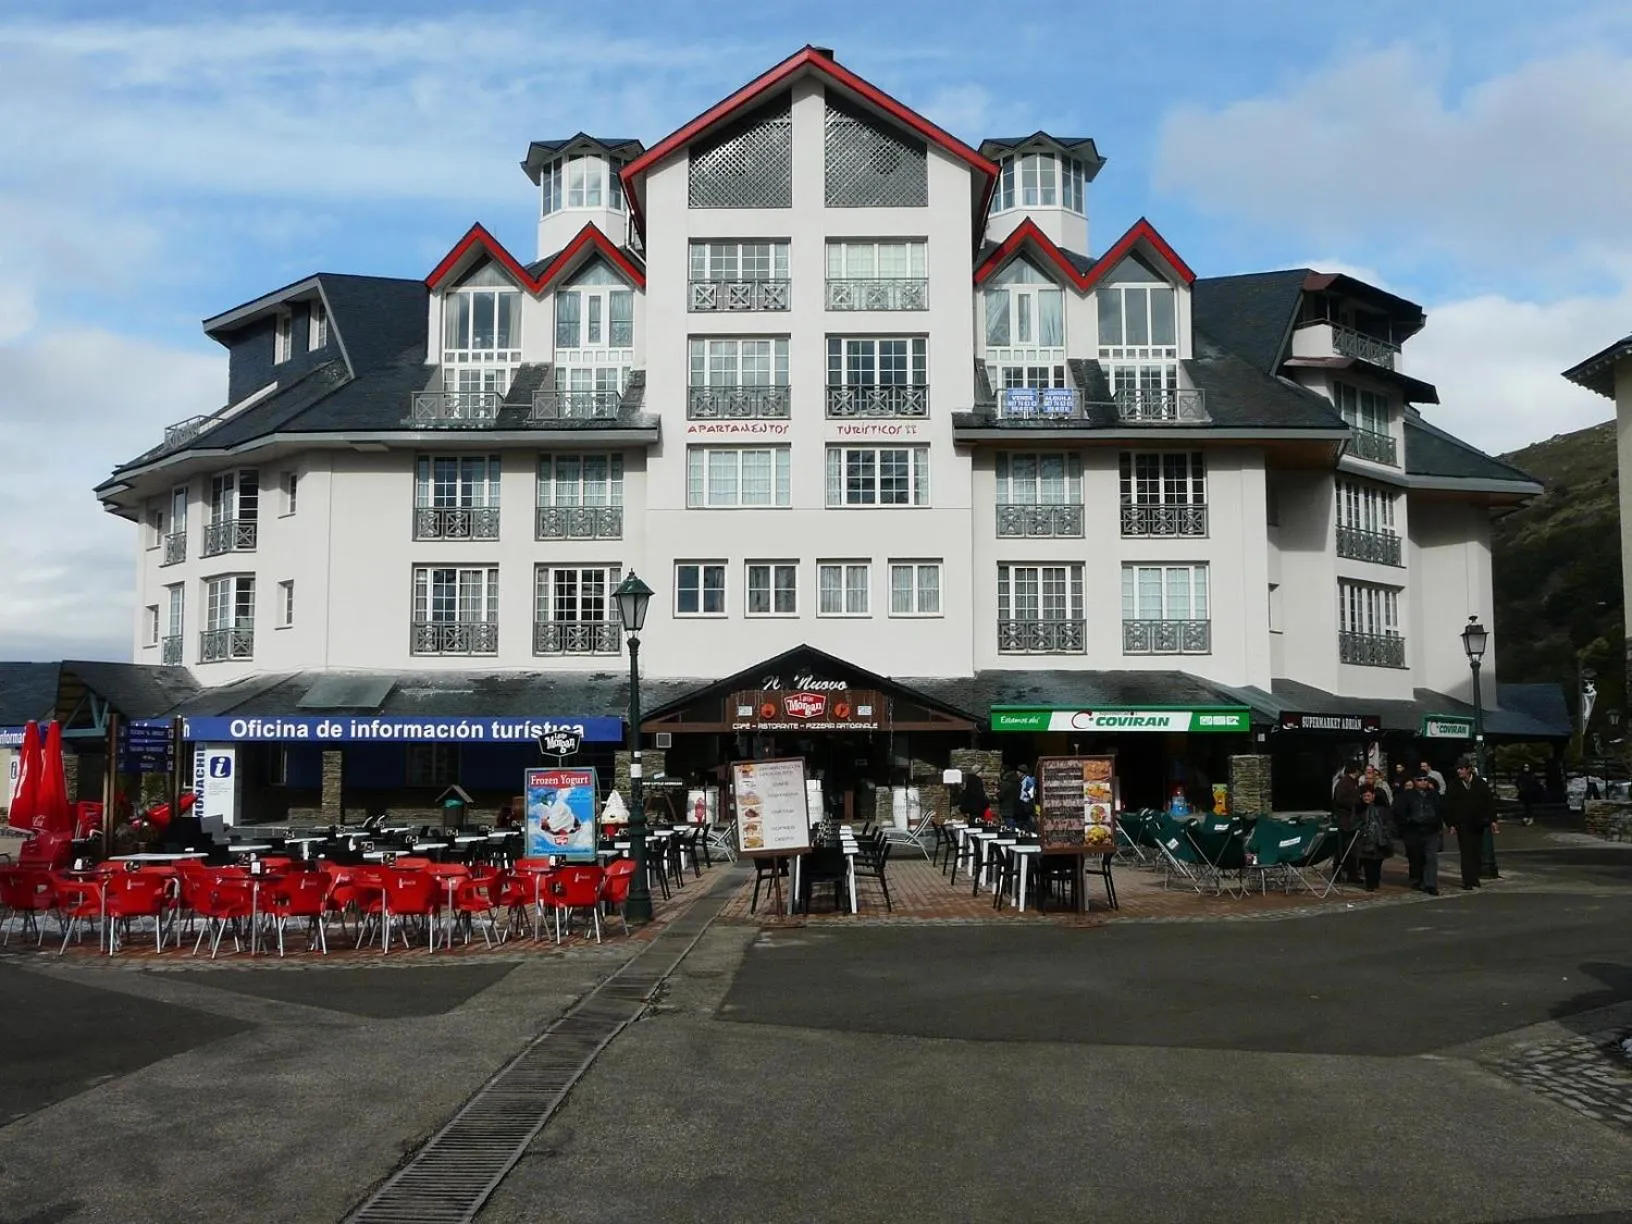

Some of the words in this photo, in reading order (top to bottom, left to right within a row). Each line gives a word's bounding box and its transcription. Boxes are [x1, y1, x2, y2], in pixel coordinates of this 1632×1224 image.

[687, 423, 789, 435] APARTAMENTOS
[836, 422, 903, 435] TURÍSTICOS
[787, 699, 821, 716] Morgan
[757, 722, 799, 730] RISTORANTE
[1096, 716, 1170, 727] COVIRAN
[1302, 716, 1341, 729] SUPERMARKET
[230, 719, 309, 738] Oficina
[316, 719, 343, 738] de
[350, 719, 484, 738] información
[1439, 724, 1467, 734] COVIRAN
[544, 736, 575, 754] Morgan
[530, 775, 559, 785] Frozen
[560, 774, 589, 788] Yogurt
